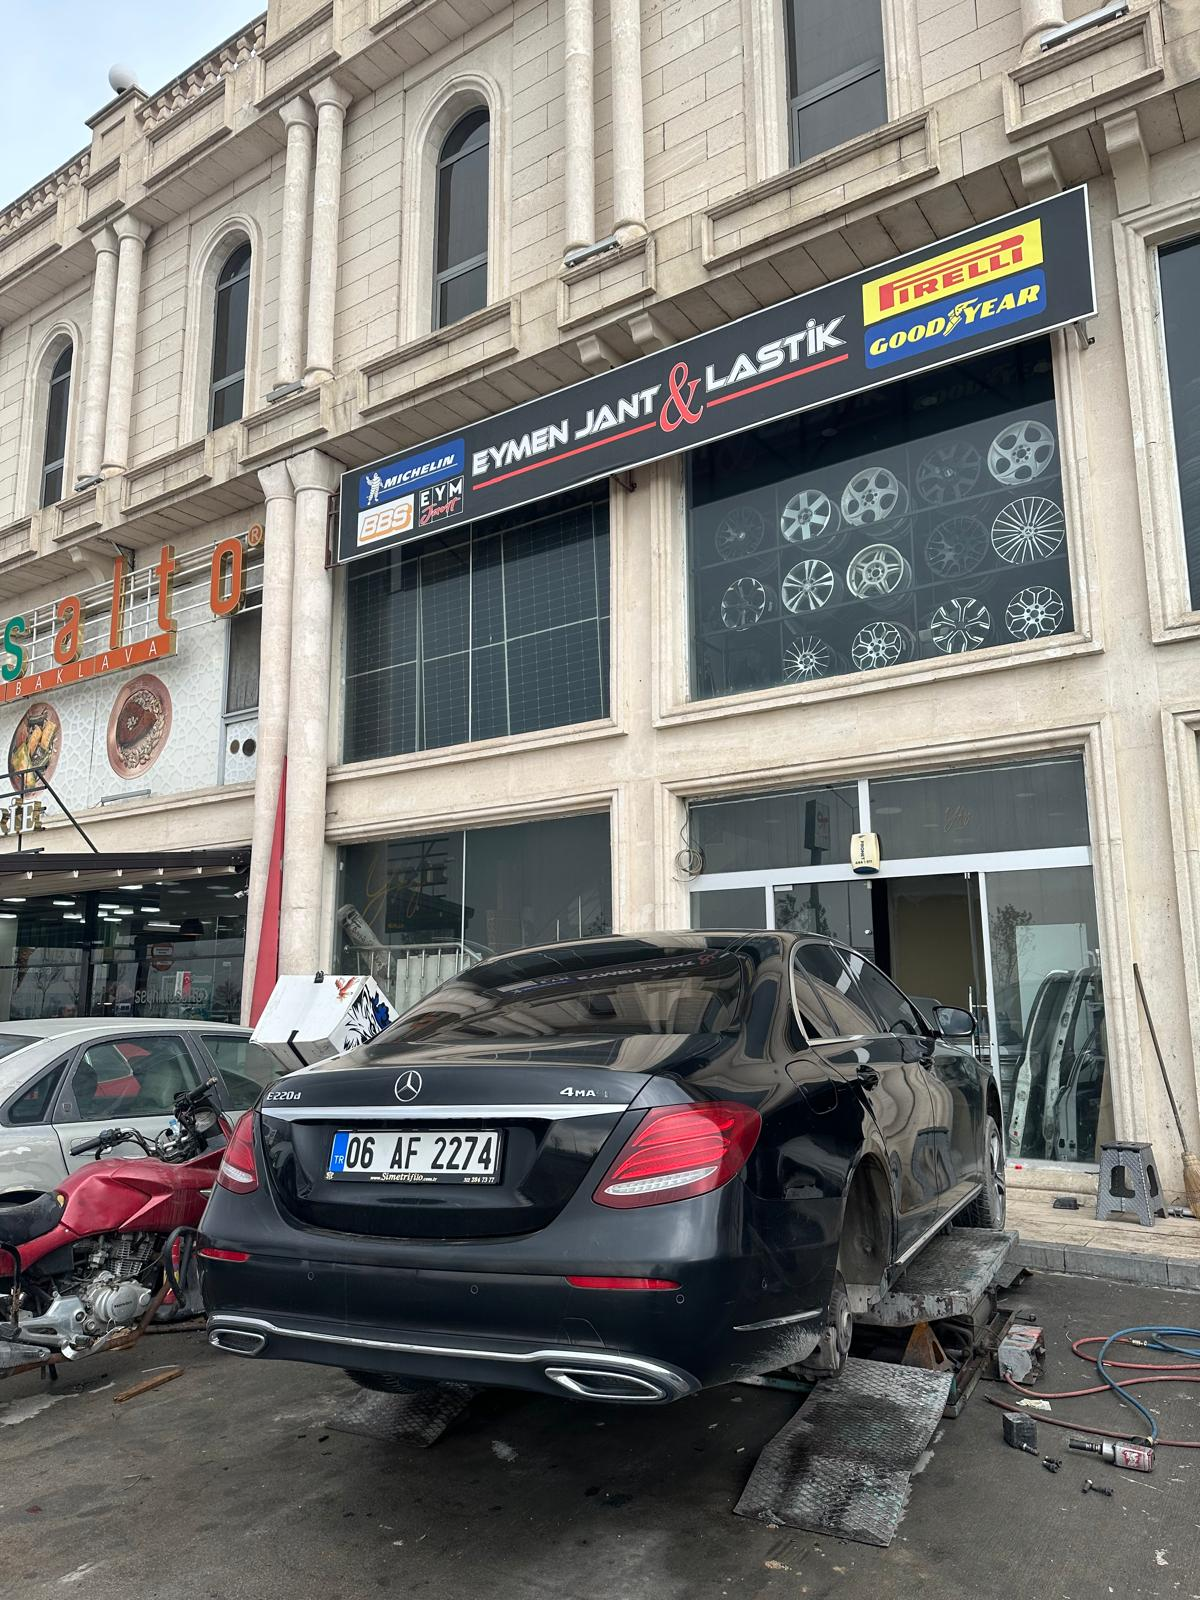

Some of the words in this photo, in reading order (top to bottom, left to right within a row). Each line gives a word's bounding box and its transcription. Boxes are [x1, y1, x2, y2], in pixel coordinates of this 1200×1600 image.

[879, 235, 1024, 311] PIRELLI
[471, 419, 569, 477] EYMEN
[574, 384, 662, 440] JANT
[660, 362, 703, 432] &
[705, 315, 847, 393] LASTİK
[384, 454, 455, 489] MICHELIN
[420, 478, 462, 507] EYM
[359, 504, 412, 542] BBS
[15, 641, 158, 696] BAKLAVA
[266, 1091, 302, 1101] E220d
[333, 1155, 344, 1165] TR
[346, 1136, 375, 1169] 06
[389, 1136, 422, 1170] AF
[430, 1135, 493, 1171] 2274
